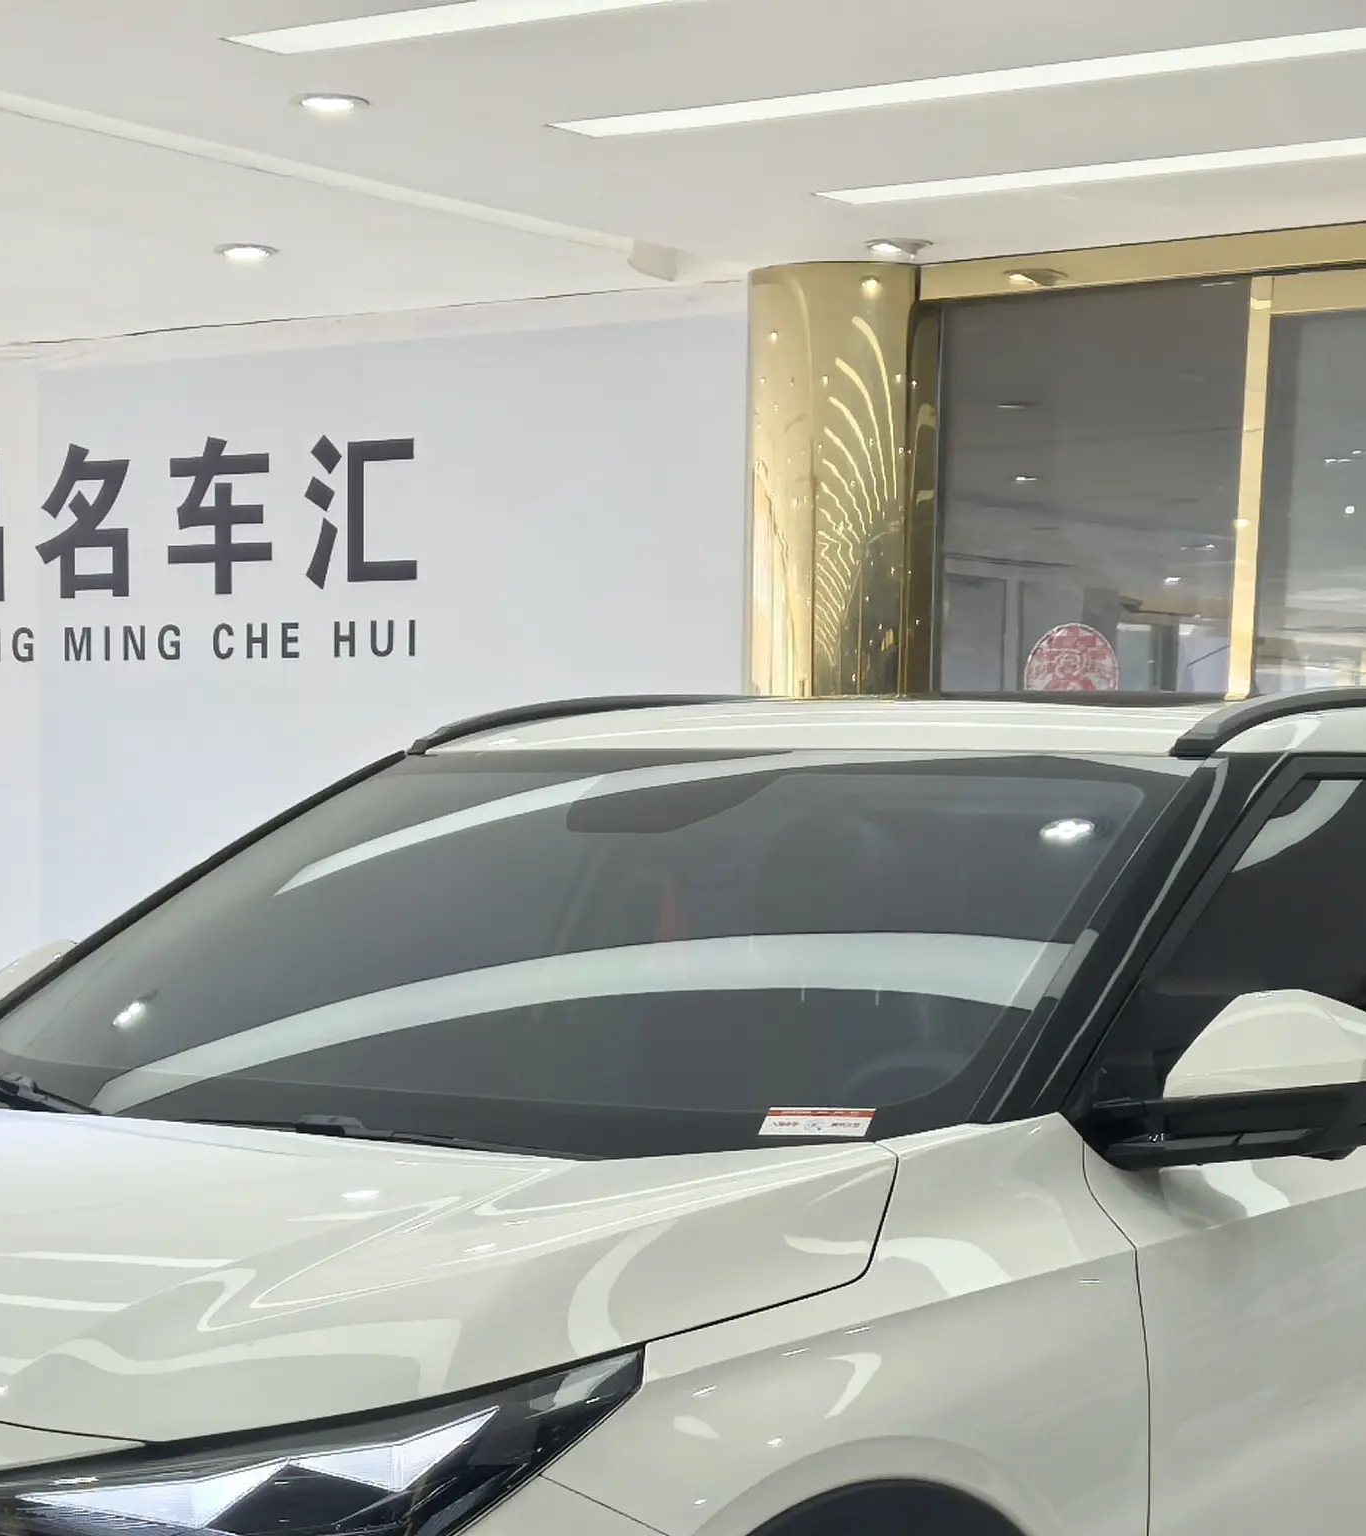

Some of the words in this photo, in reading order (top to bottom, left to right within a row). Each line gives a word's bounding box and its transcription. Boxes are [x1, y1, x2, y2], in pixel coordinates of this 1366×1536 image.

[64, 624, 181, 662] MING
[212, 622, 300, 661] CHE
[333, 619, 416, 658] HUI
